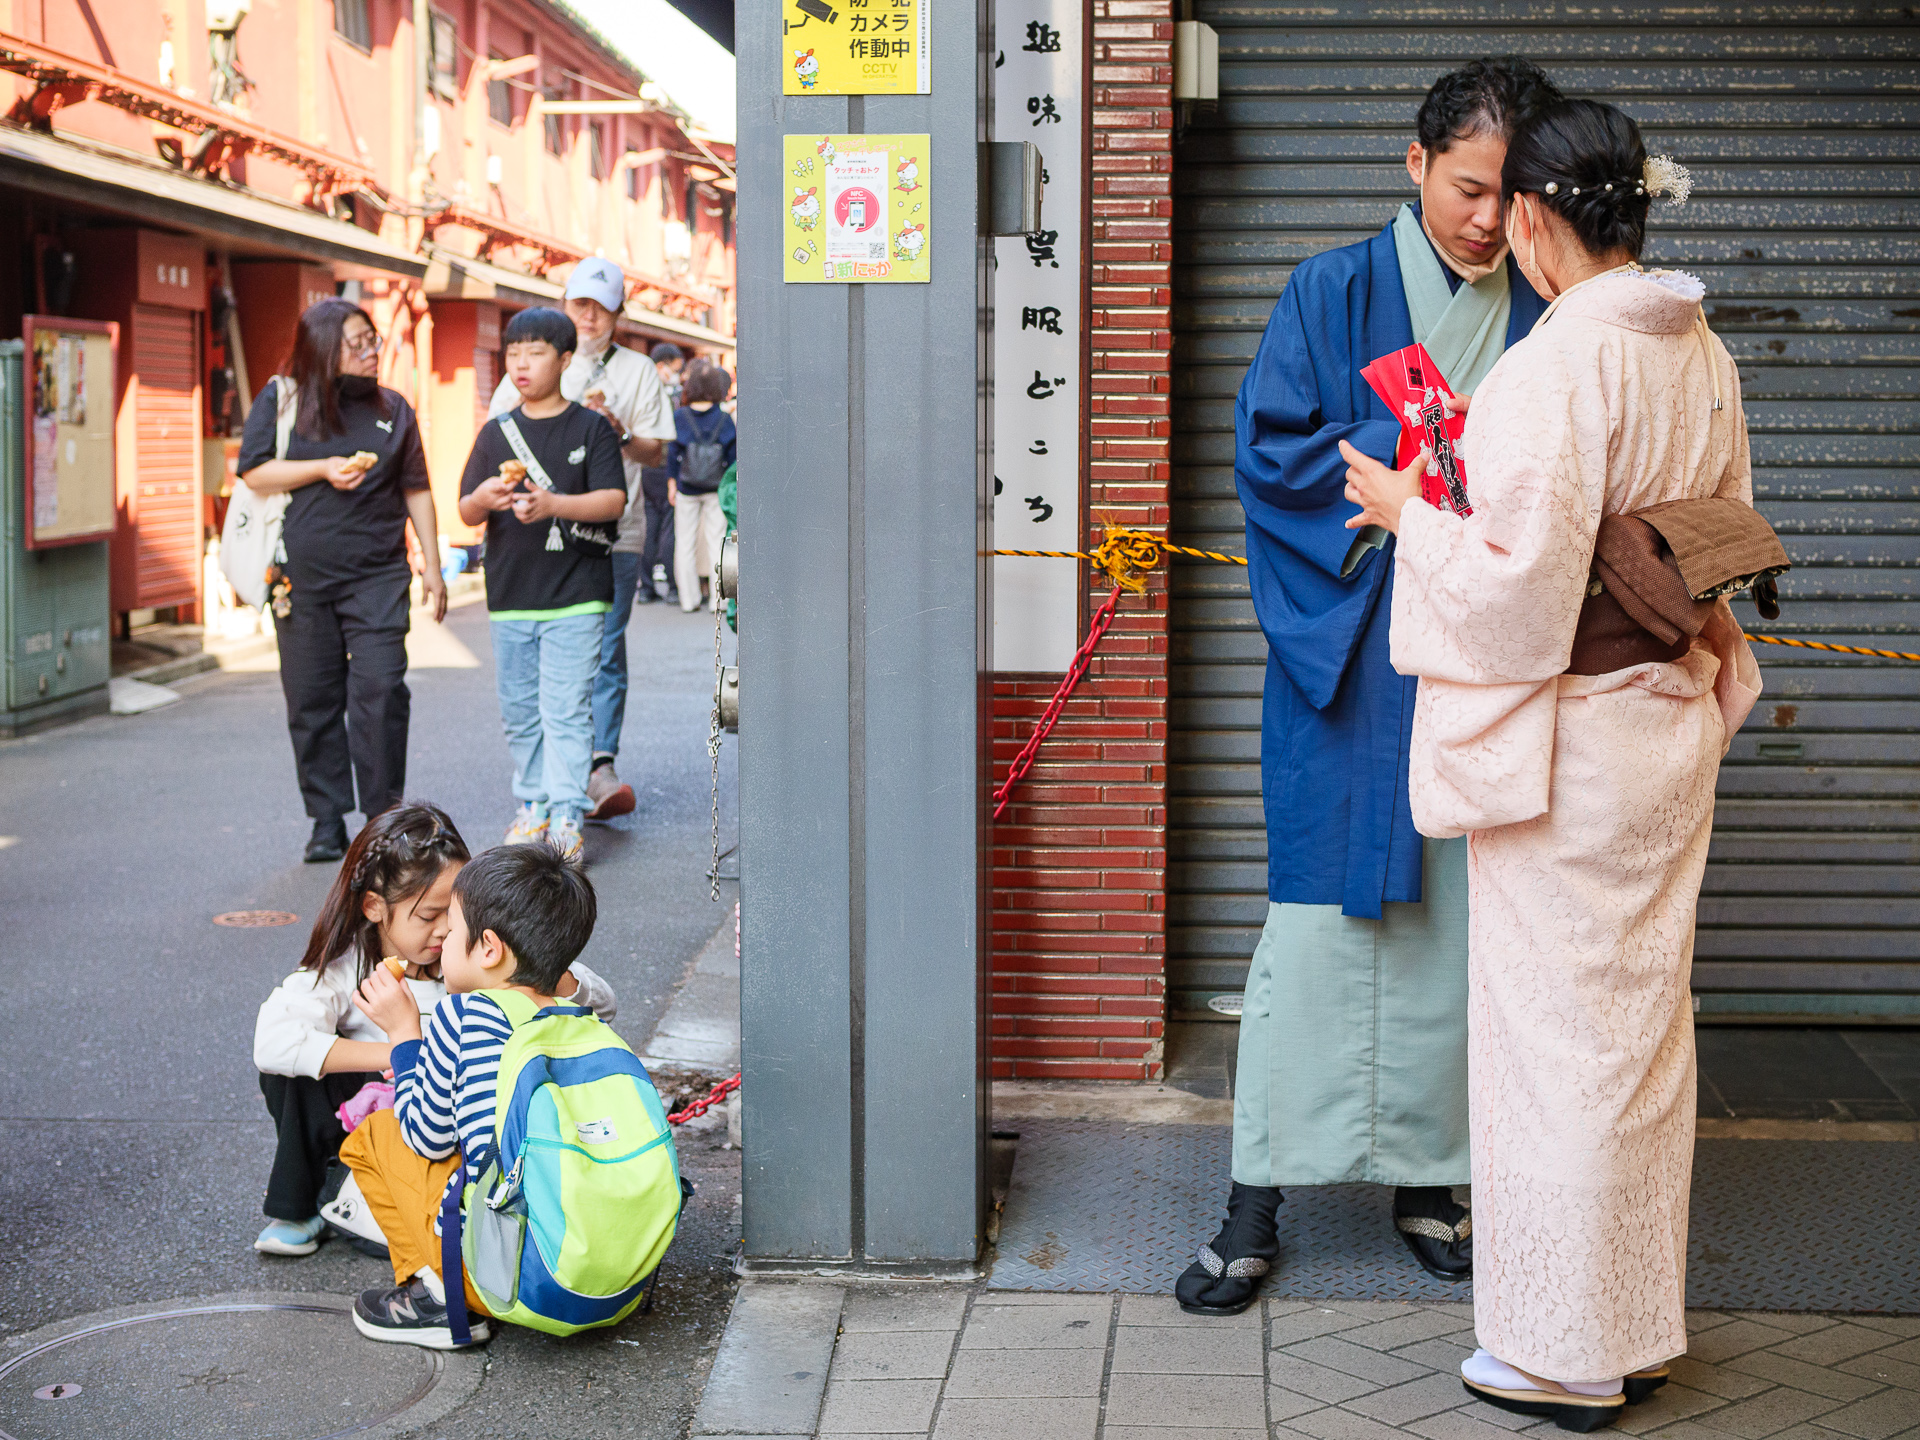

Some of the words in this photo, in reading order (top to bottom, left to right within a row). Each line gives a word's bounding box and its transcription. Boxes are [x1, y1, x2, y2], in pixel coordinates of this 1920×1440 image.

[850, 14, 909, 32] カメラ
[849, 38, 910, 59] 作動中
[862, 63, 898, 74] CCTV
[1022, 20, 1067, 523] 趣味呉服どころ
